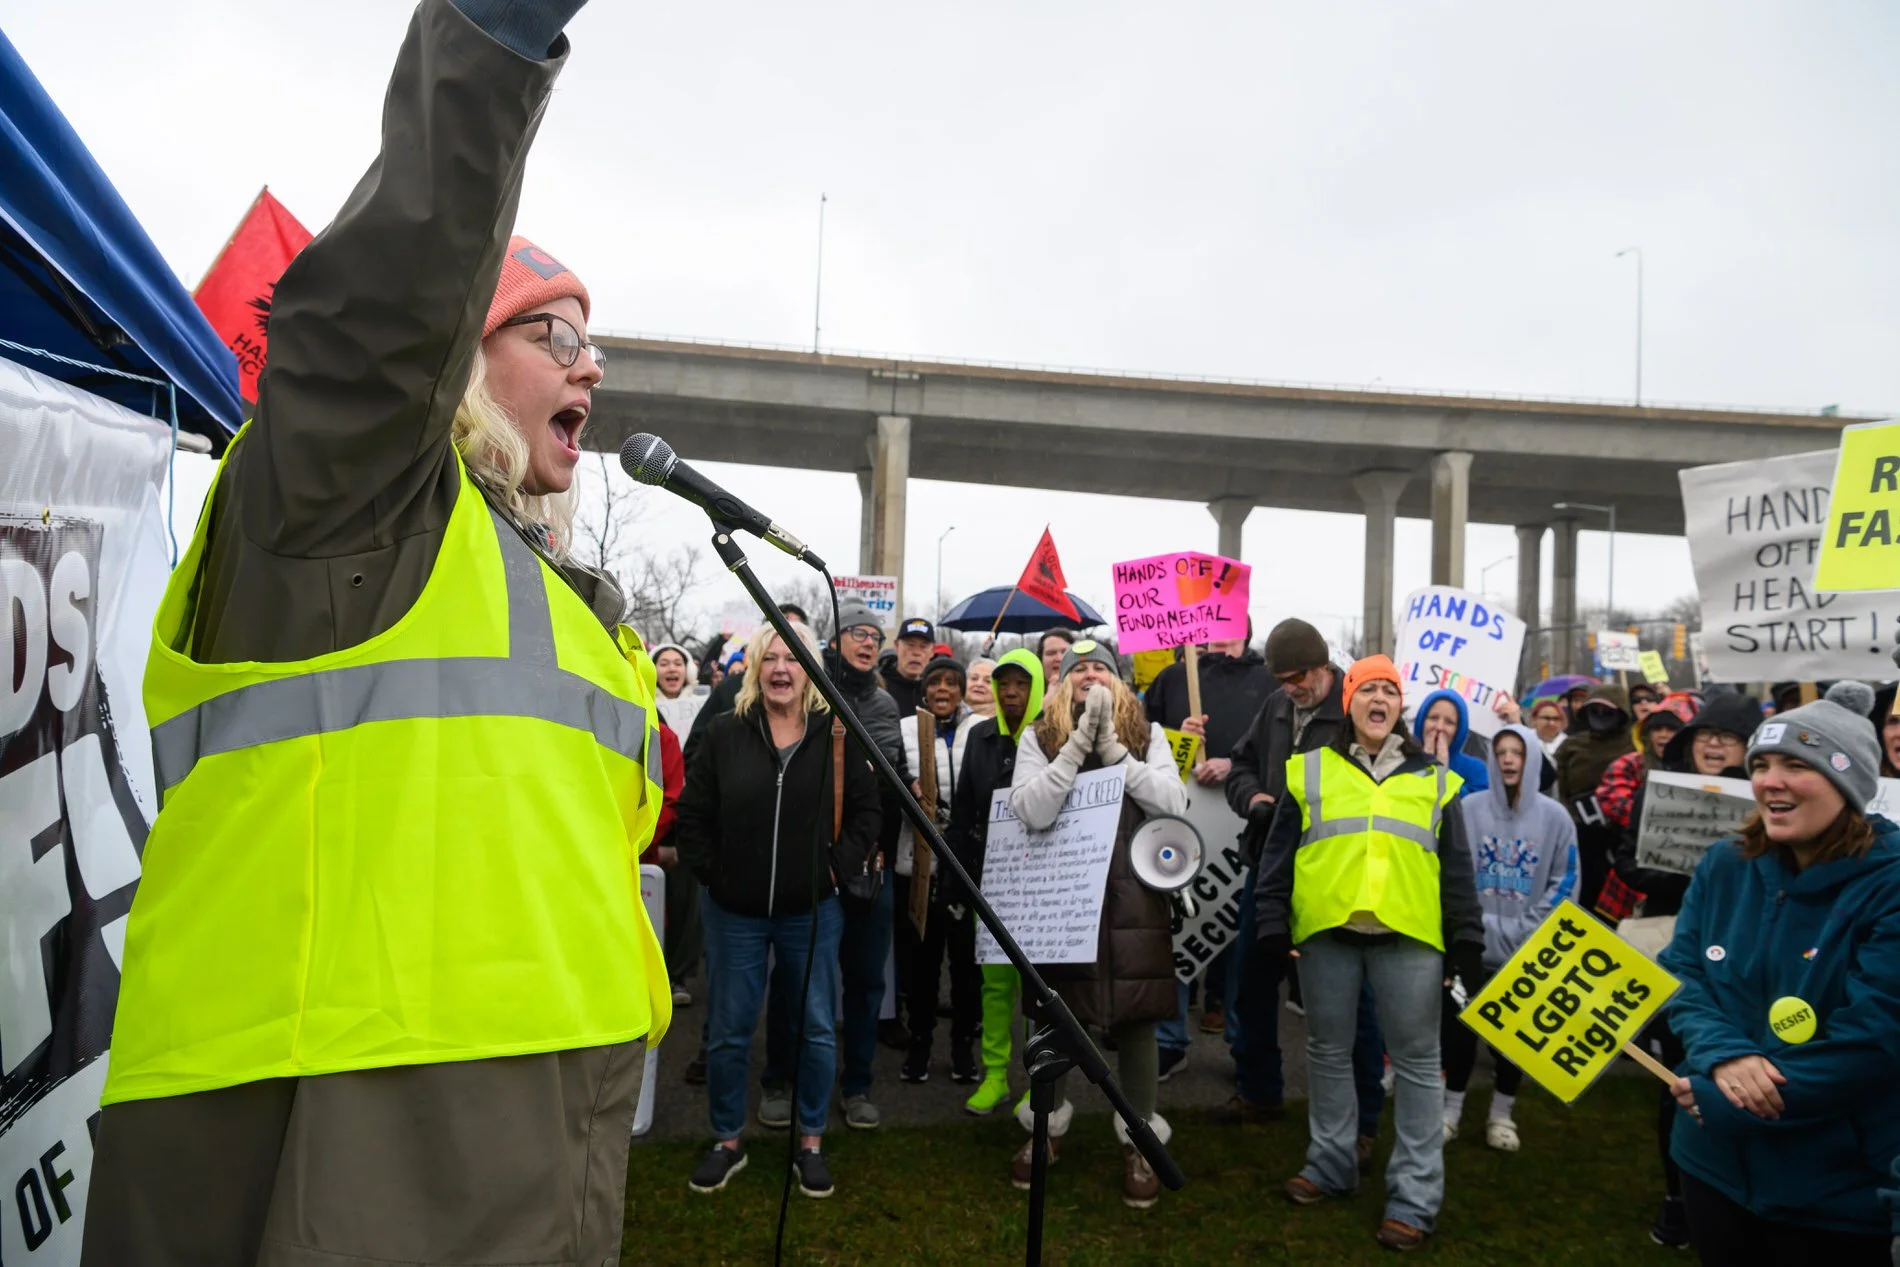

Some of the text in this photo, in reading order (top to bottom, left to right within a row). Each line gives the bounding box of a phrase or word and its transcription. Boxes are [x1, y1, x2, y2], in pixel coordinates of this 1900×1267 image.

[1835, 509, 1900, 548] FA
[1117, 561, 1168, 585] HANDS
[1119, 587, 1164, 610] OUR
[1118, 605, 1231, 633] FUNDAMENTAL
[1407, 594, 1505, 641] HANDS
[1156, 627, 1209, 646] RIGHTS
[1418, 629, 1468, 657] OFF
[1087, 777, 1123, 805] CREED
[1477, 917, 1587, 1031] Protect
[1515, 948, 1622, 1053] LGBTQ
[1551, 977, 1651, 1078] Rights
[1773, 1007, 1812, 1034] RESIST
